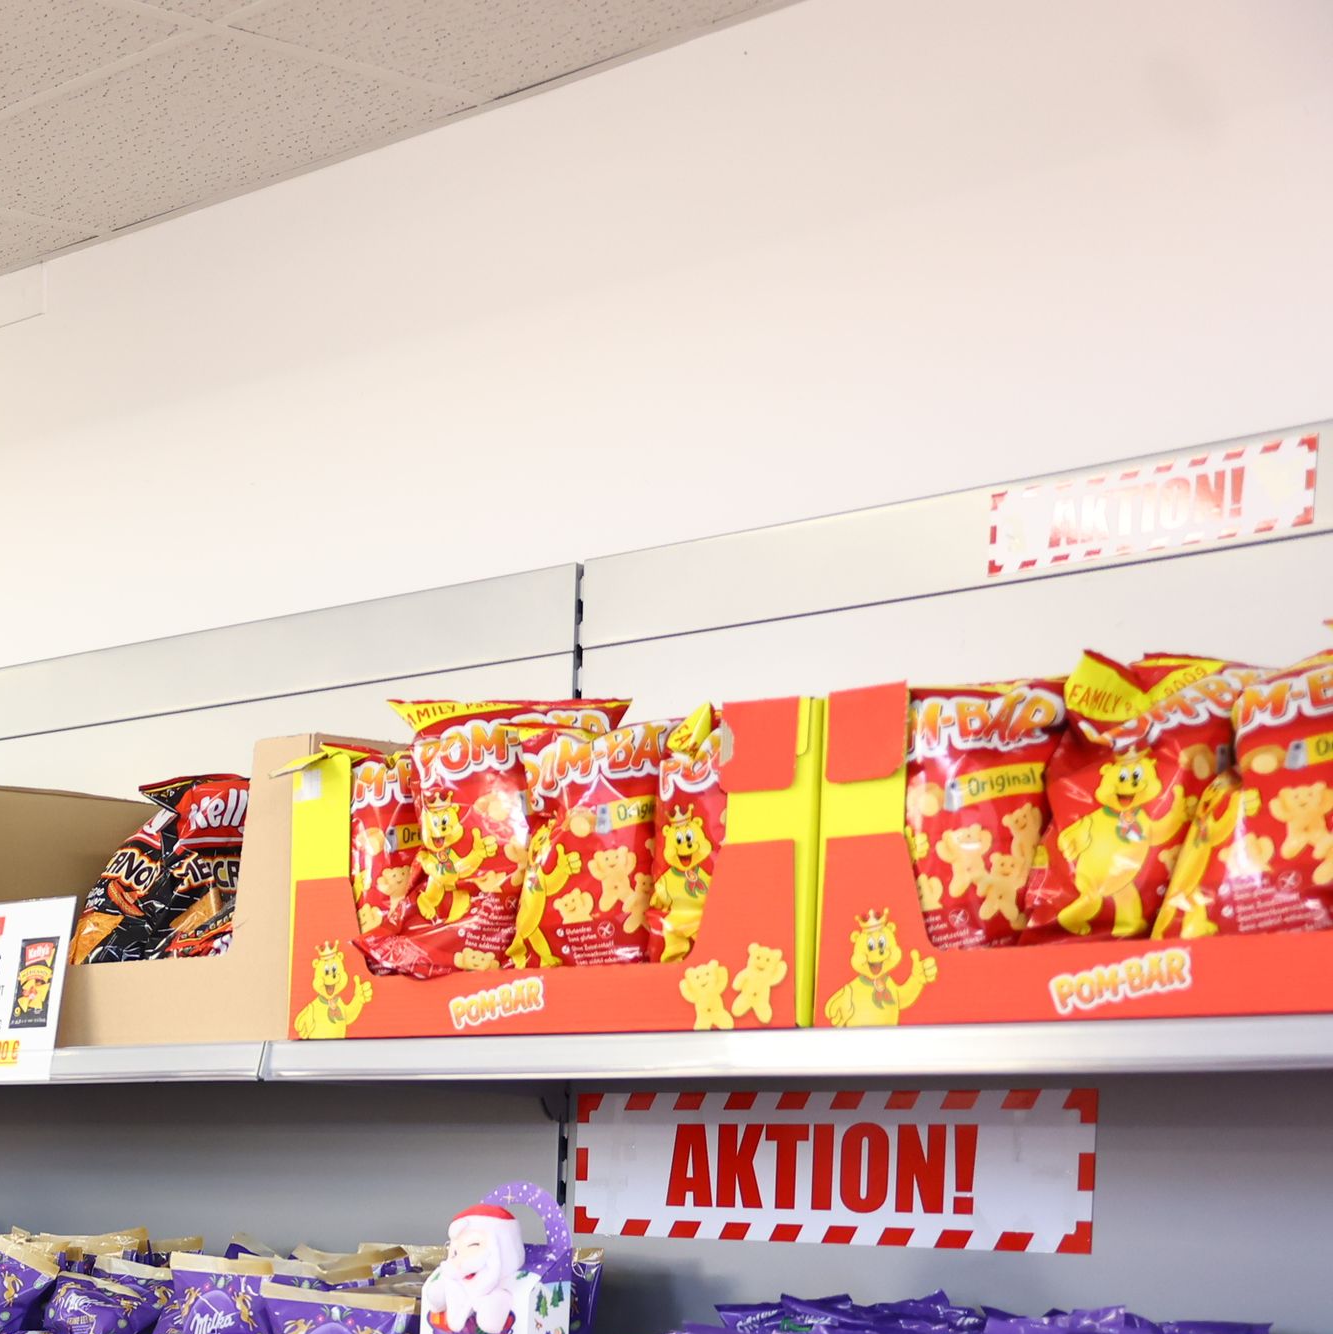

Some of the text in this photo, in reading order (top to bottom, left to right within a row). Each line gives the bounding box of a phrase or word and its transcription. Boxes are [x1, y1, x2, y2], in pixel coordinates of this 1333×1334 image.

[1048, 466, 1245, 548] AKTION!
[967, 768, 1036, 797] Original
[12, 1040, 20, 1061] €
[665, 1121, 979, 1215] AKTION!
